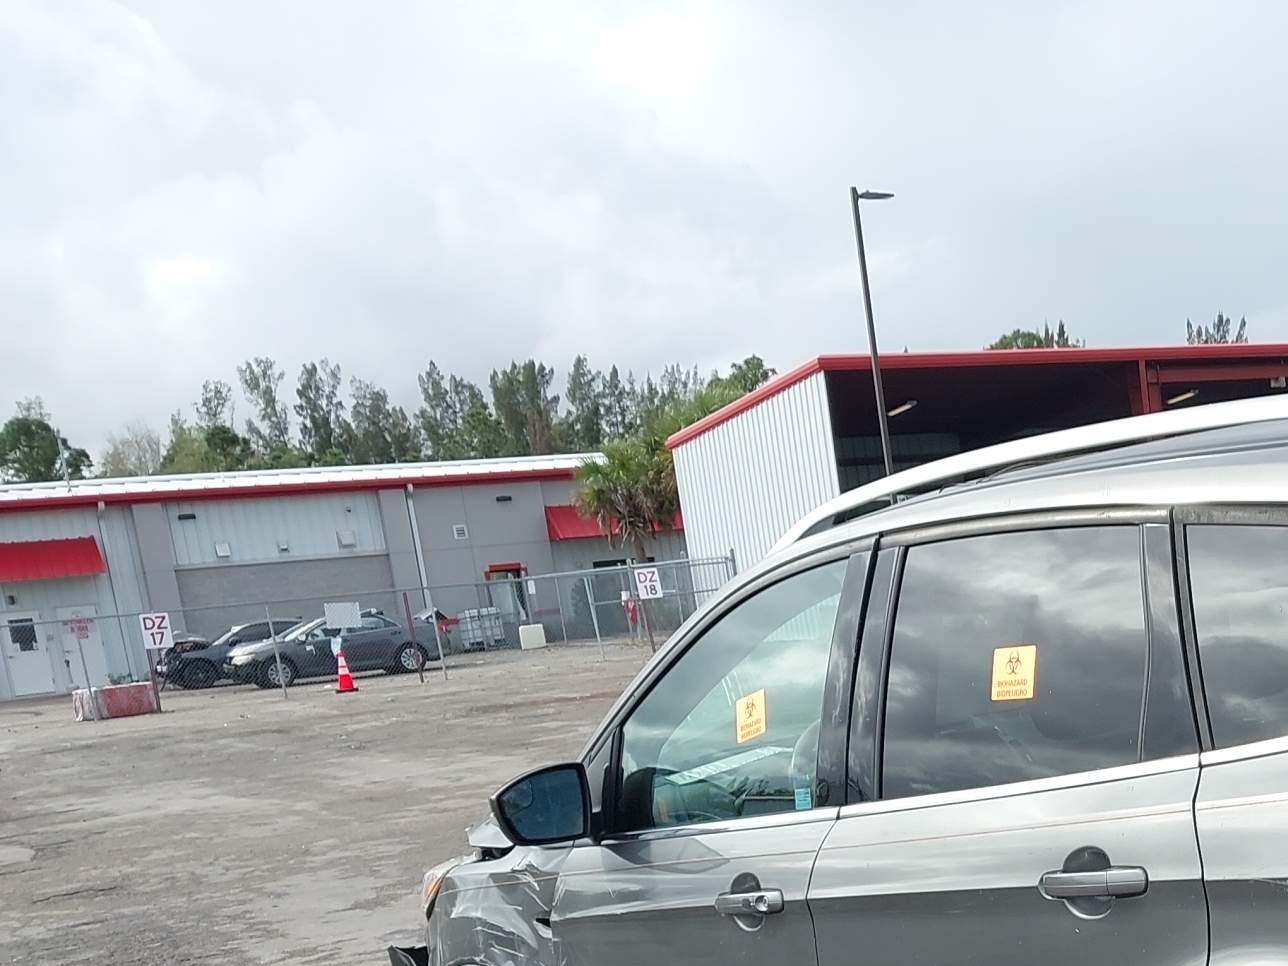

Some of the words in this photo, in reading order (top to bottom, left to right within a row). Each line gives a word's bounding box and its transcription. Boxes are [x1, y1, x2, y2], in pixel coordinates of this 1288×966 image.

[637, 570, 658, 584] DZ
[644, 584, 658, 596] 18
[142, 615, 169, 630] DZ
[150, 631, 165, 646] 17
